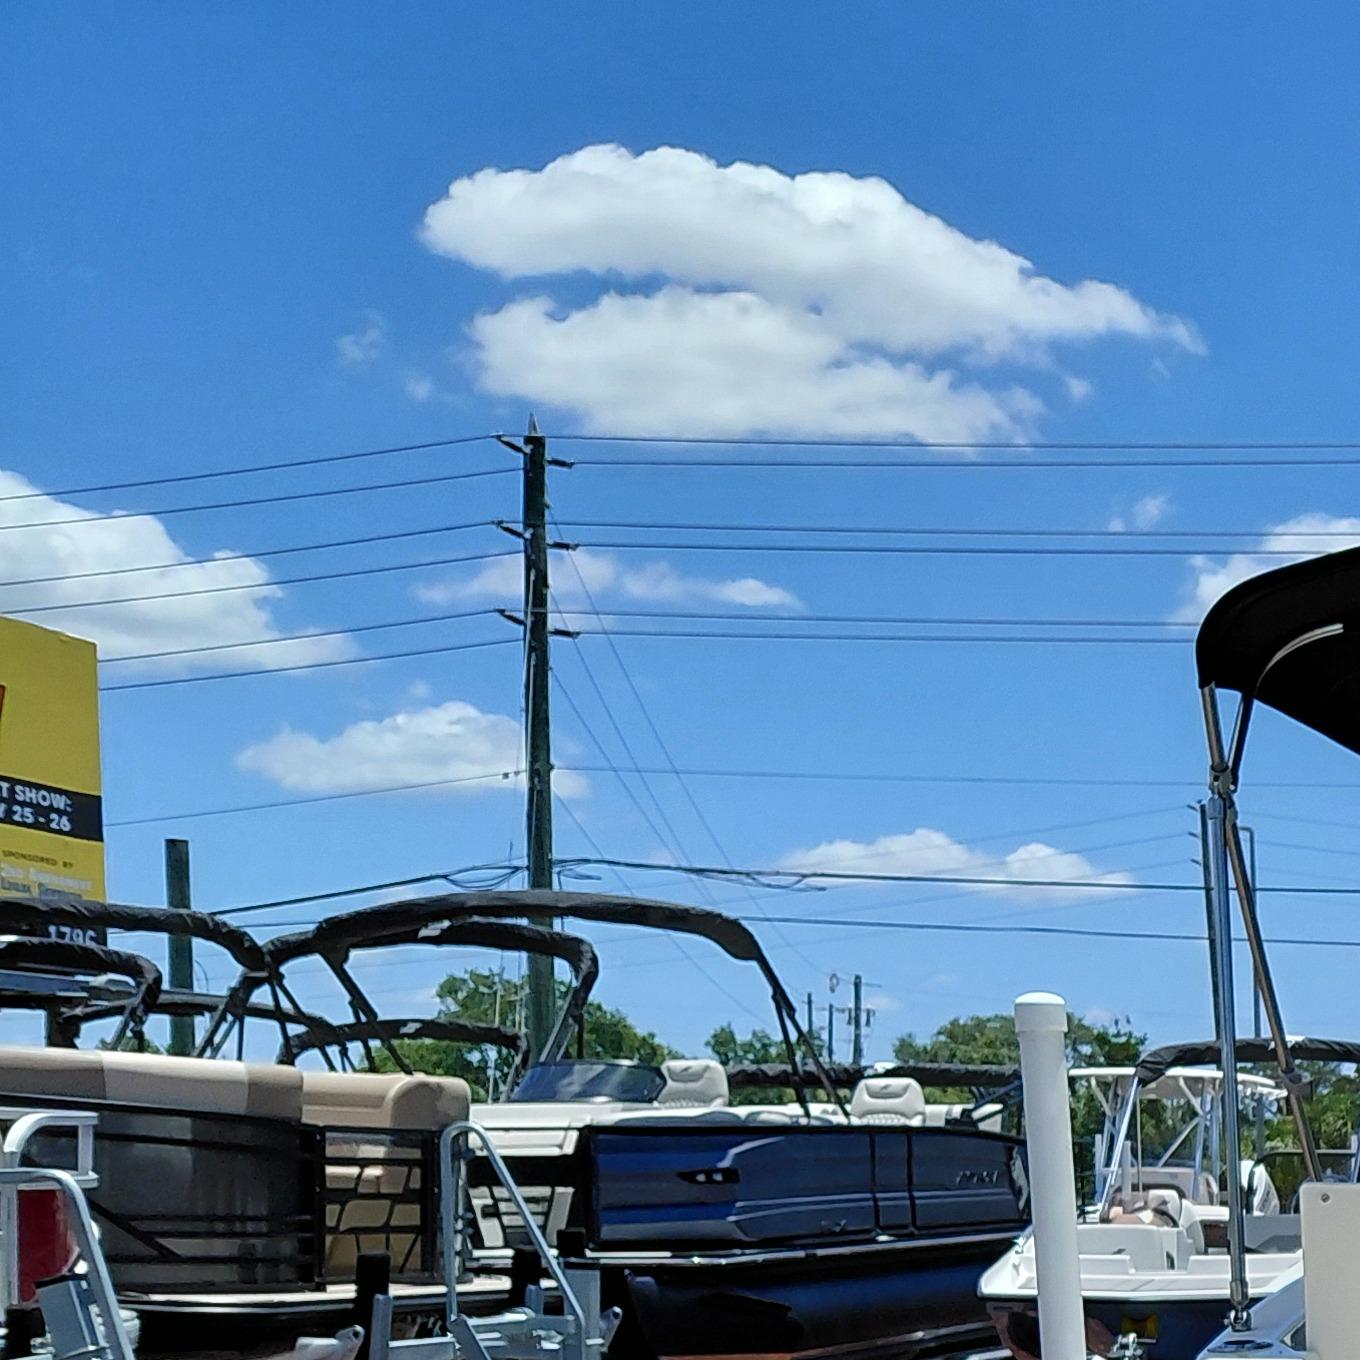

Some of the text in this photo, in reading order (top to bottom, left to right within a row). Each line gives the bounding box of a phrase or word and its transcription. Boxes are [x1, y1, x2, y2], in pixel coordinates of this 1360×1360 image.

[14, 784, 72, 812] SHOW:
[11, 804, 35, 825] 25
[49, 812, 72, 832] 26
